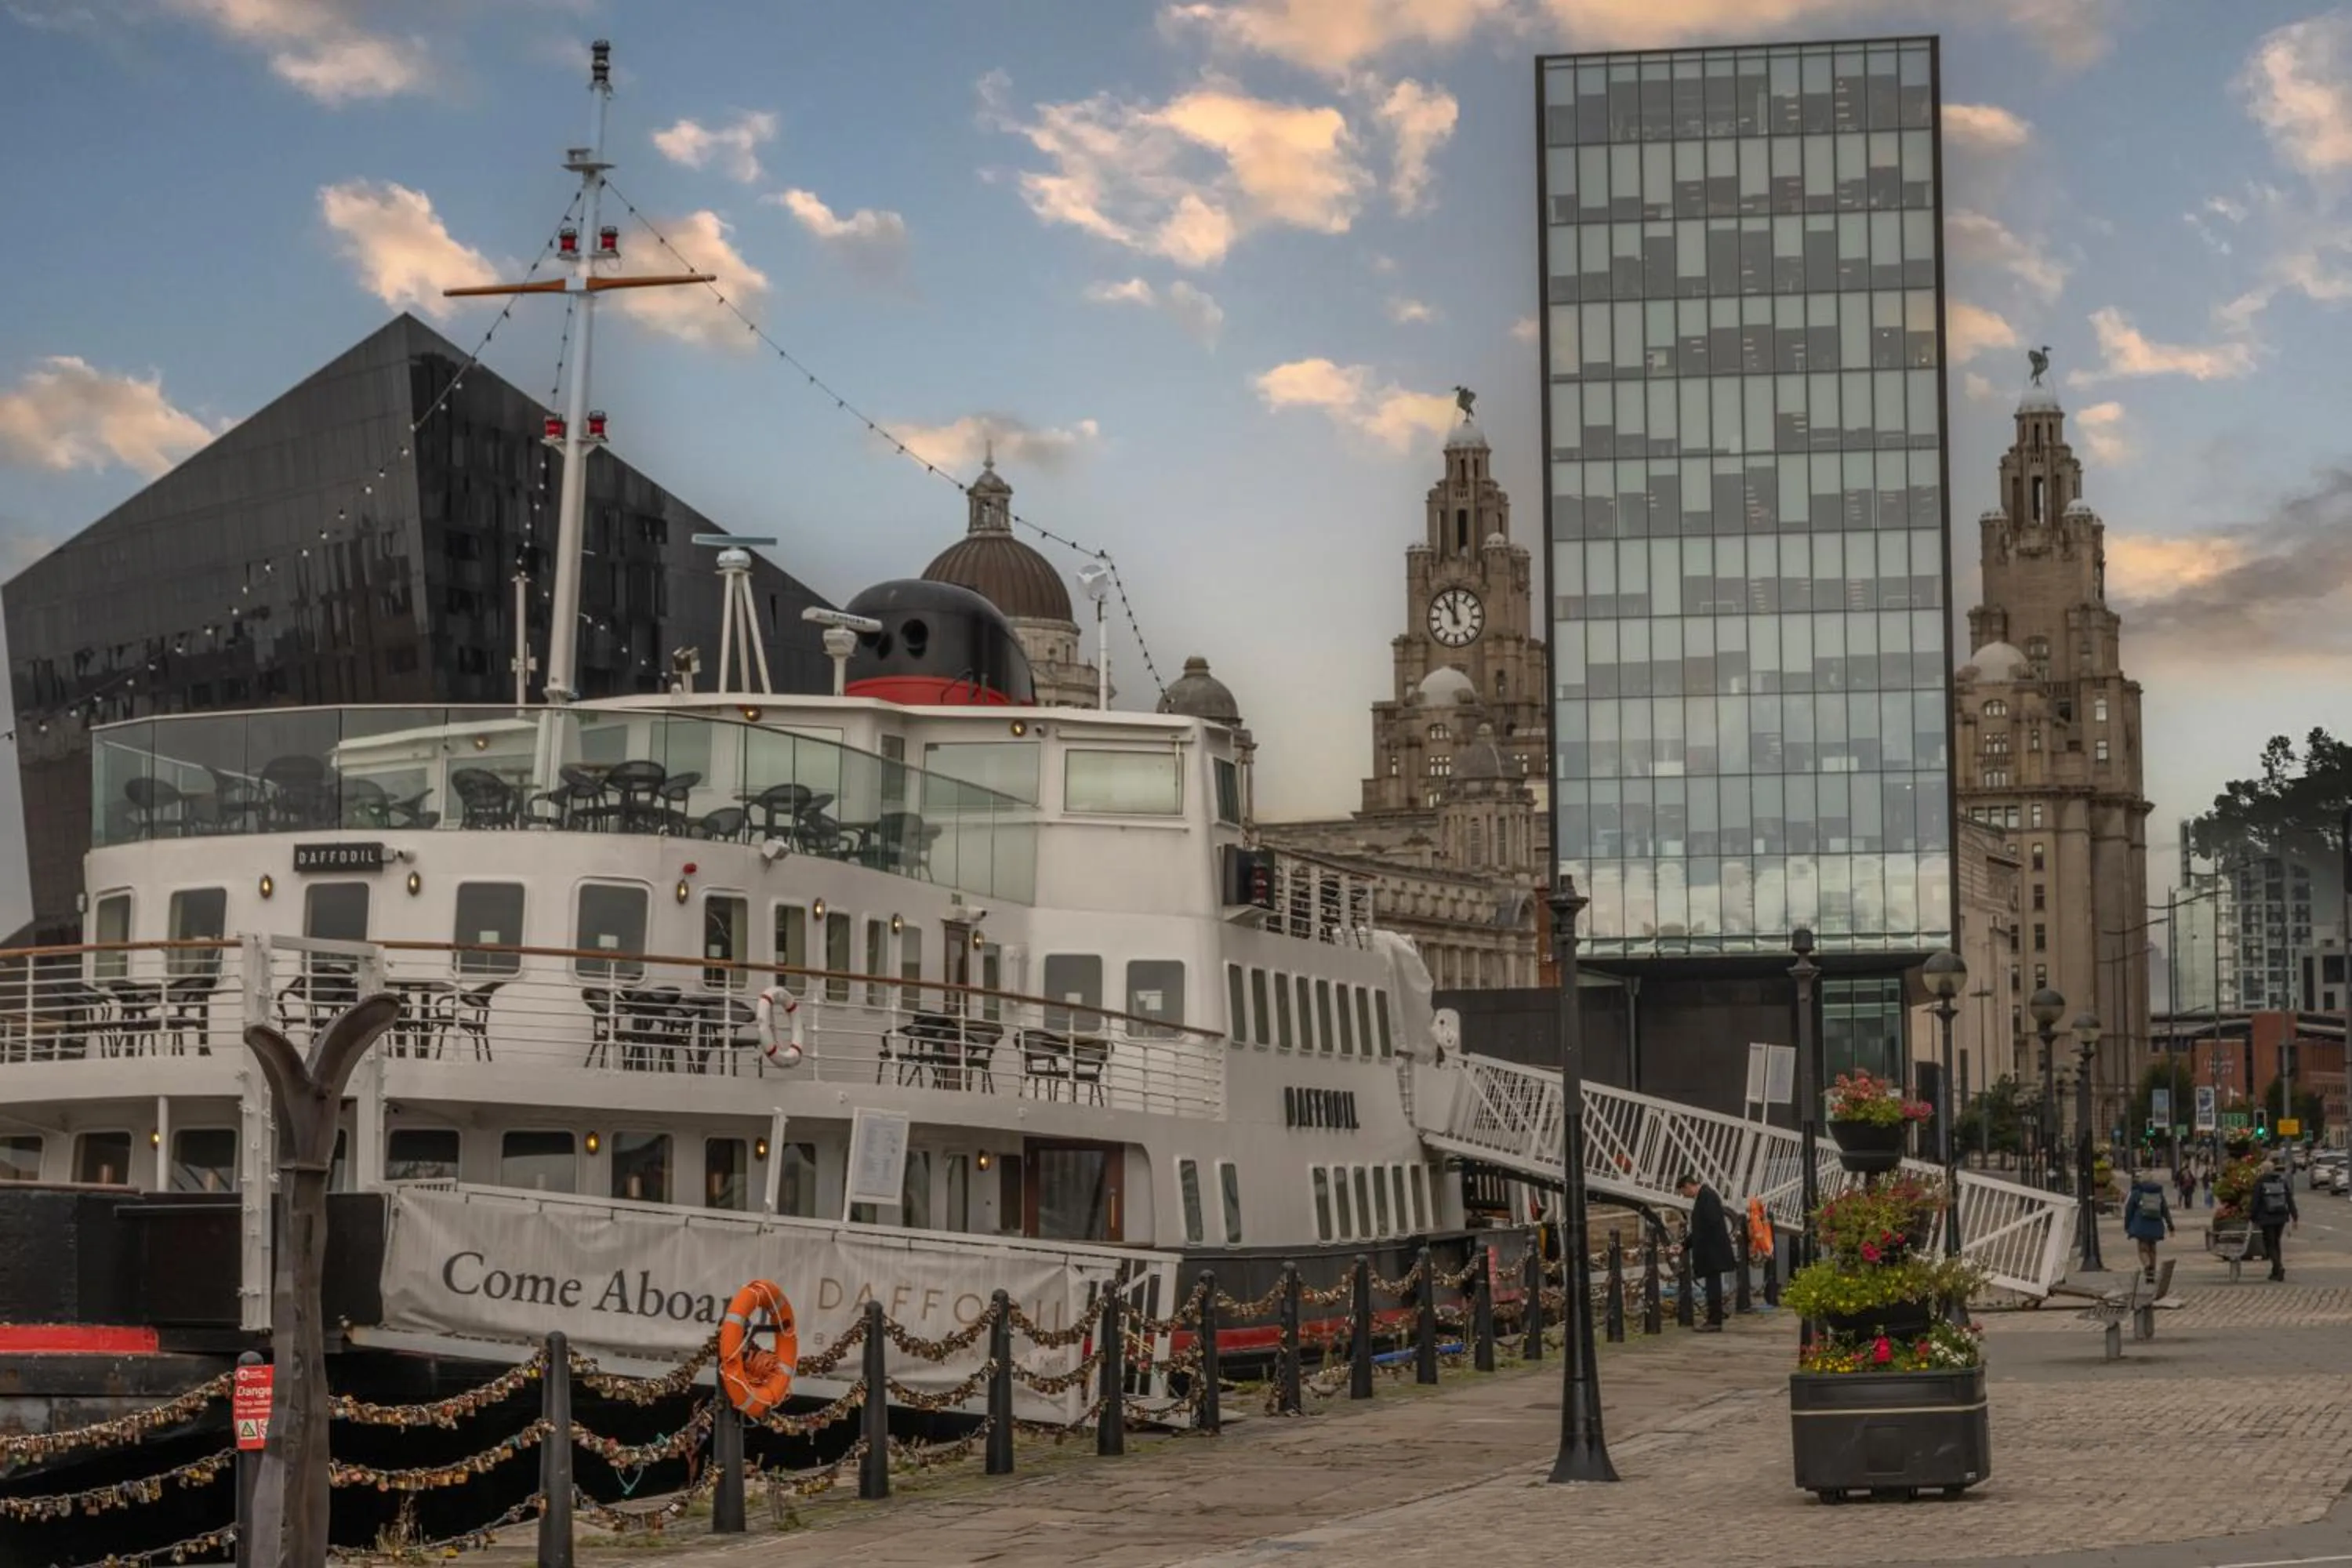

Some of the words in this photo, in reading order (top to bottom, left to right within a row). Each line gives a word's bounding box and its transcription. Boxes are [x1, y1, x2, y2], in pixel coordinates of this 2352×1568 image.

[298, 849, 375, 865] DAFFODIL
[1284, 1086, 1360, 1129] DAFFODIL
[442, 1251, 583, 1308] Come
[591, 1269, 768, 1326] Aboa
